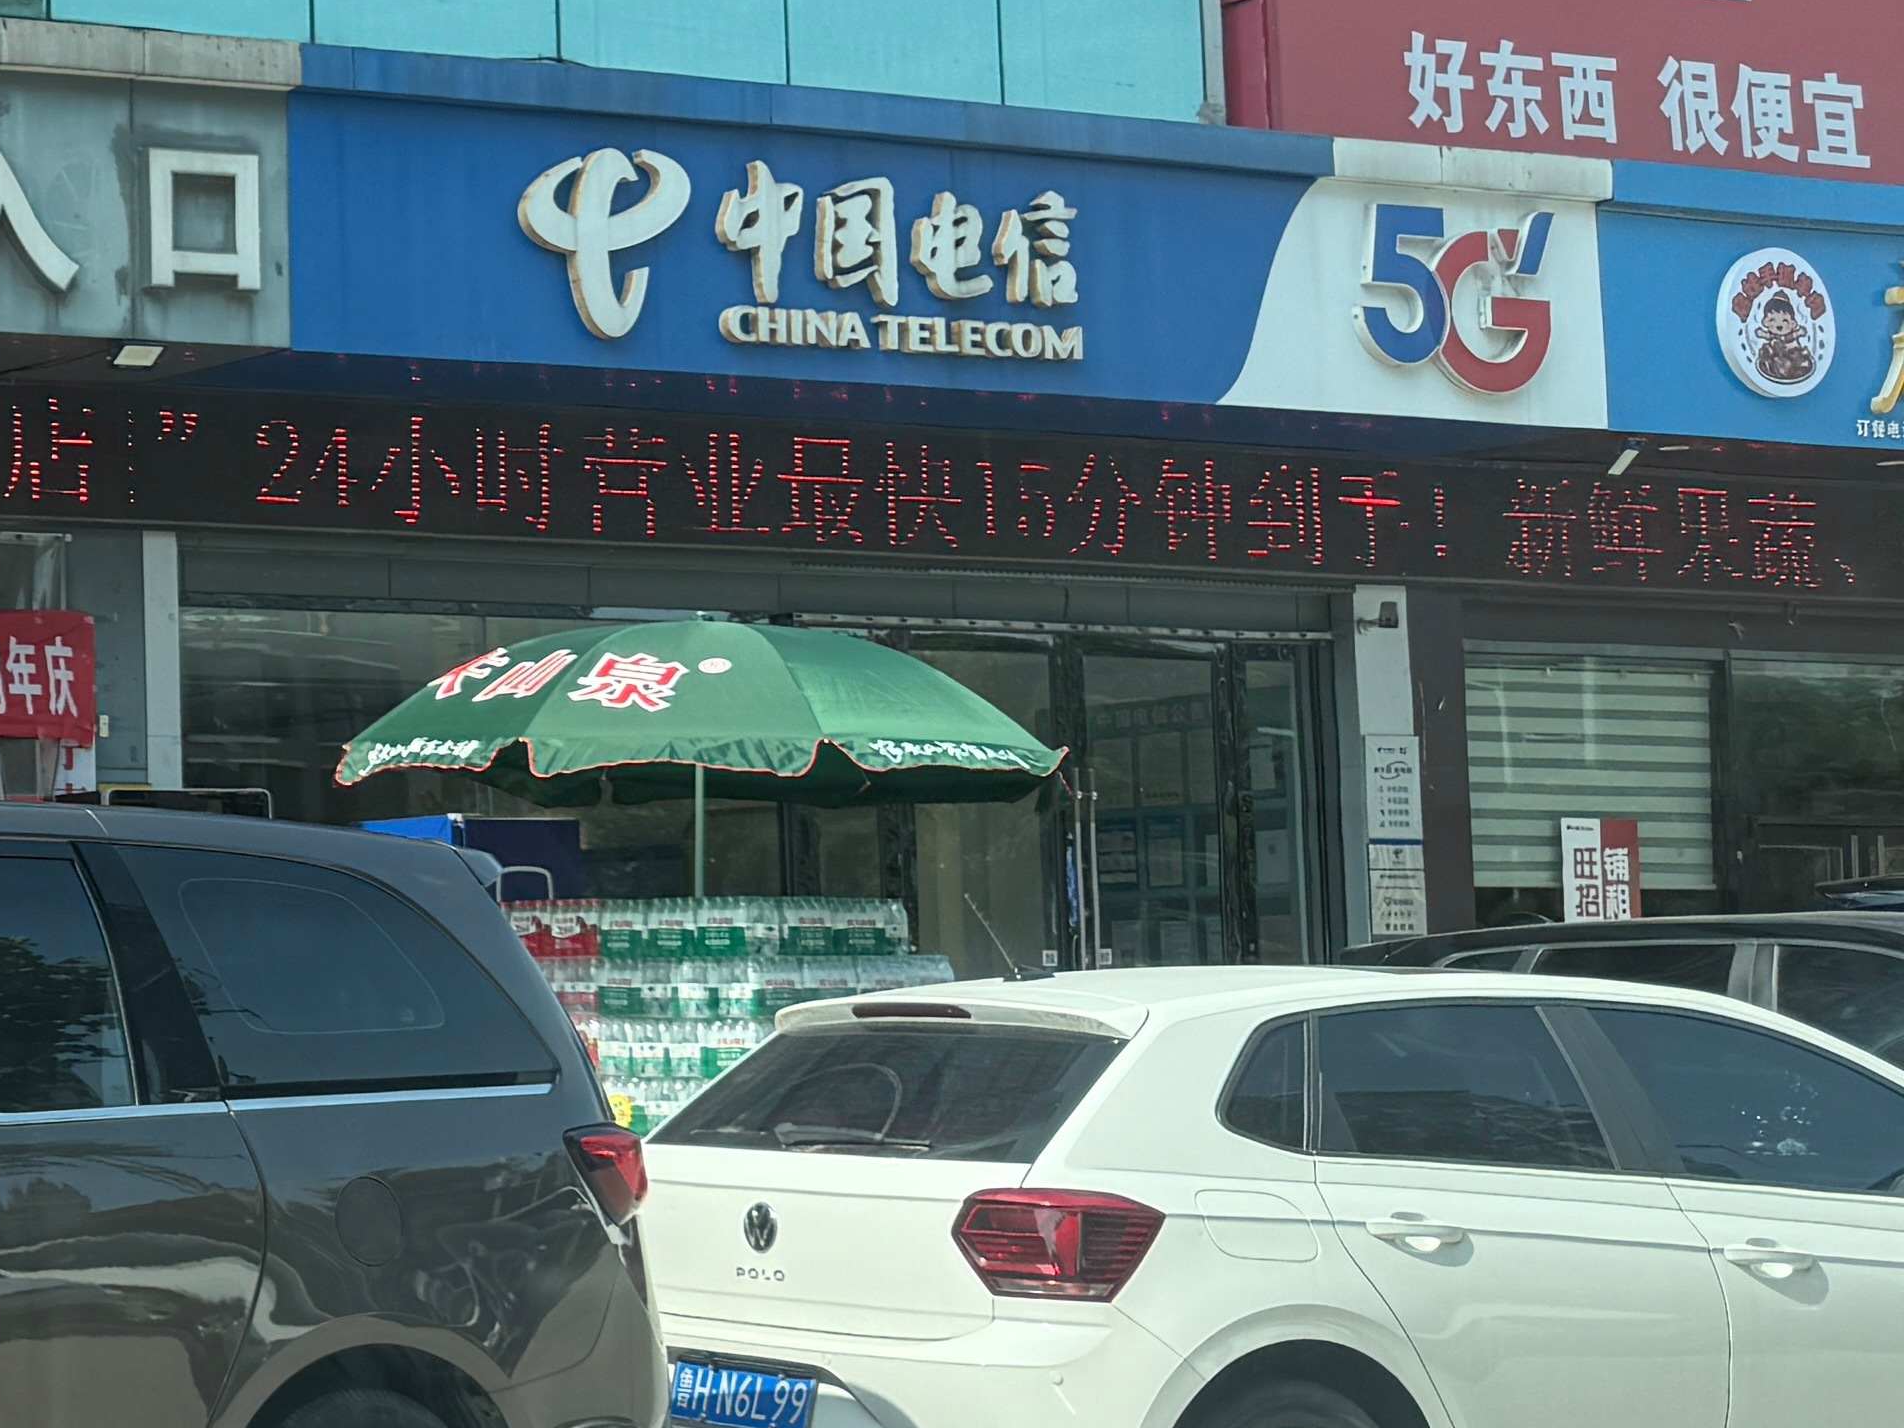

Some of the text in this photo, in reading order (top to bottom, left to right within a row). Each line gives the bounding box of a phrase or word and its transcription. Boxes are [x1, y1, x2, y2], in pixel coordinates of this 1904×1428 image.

[1403, 31, 1872, 169] 好东西 很便宜
[714, 159, 1079, 307] 中国电信
[718, 304, 1084, 361] CHINA TELECOM
[1352, 202, 1555, 395] 5G
[1856, 419, 1904, 439] 订餐电
[737, 1267, 786, 1283] POLO
